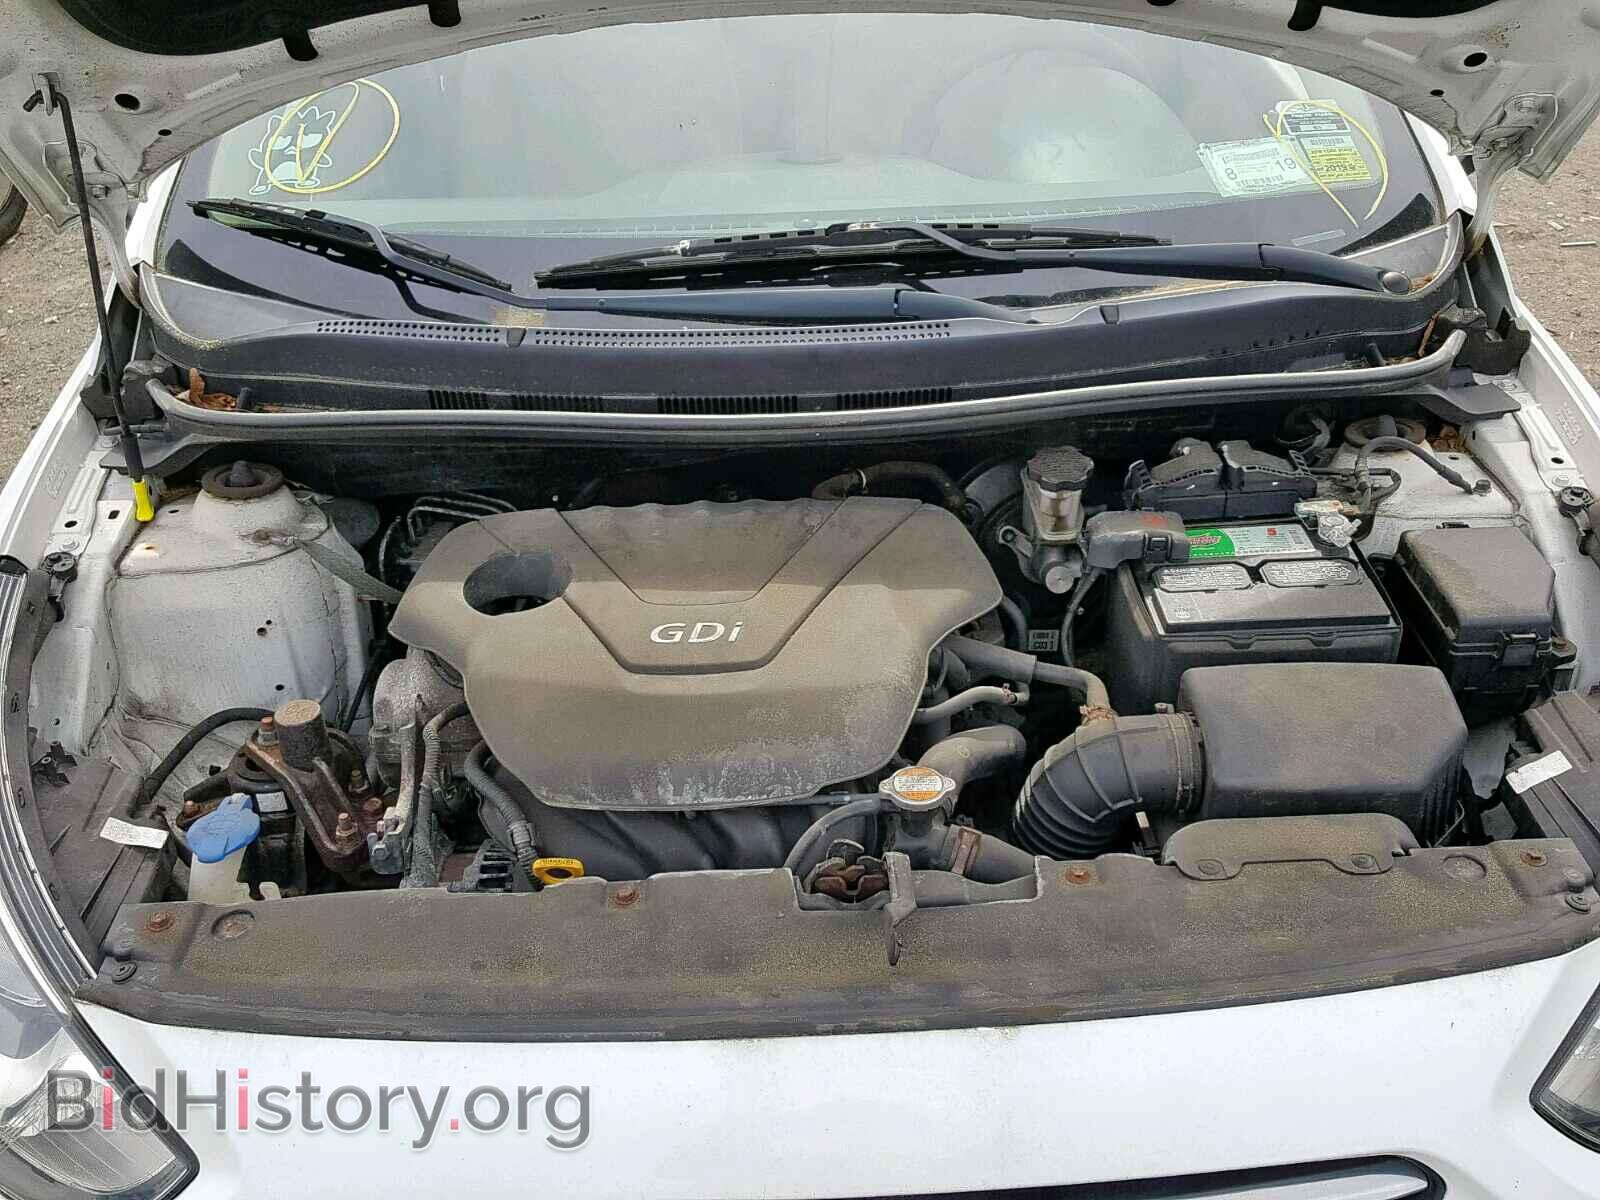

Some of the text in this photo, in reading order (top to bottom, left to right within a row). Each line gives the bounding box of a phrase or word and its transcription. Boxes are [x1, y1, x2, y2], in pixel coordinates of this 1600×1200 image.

[1275, 158, 1297, 172] 19
[1224, 167, 1238, 181] 8
[650, 622, 743, 643] GDi
